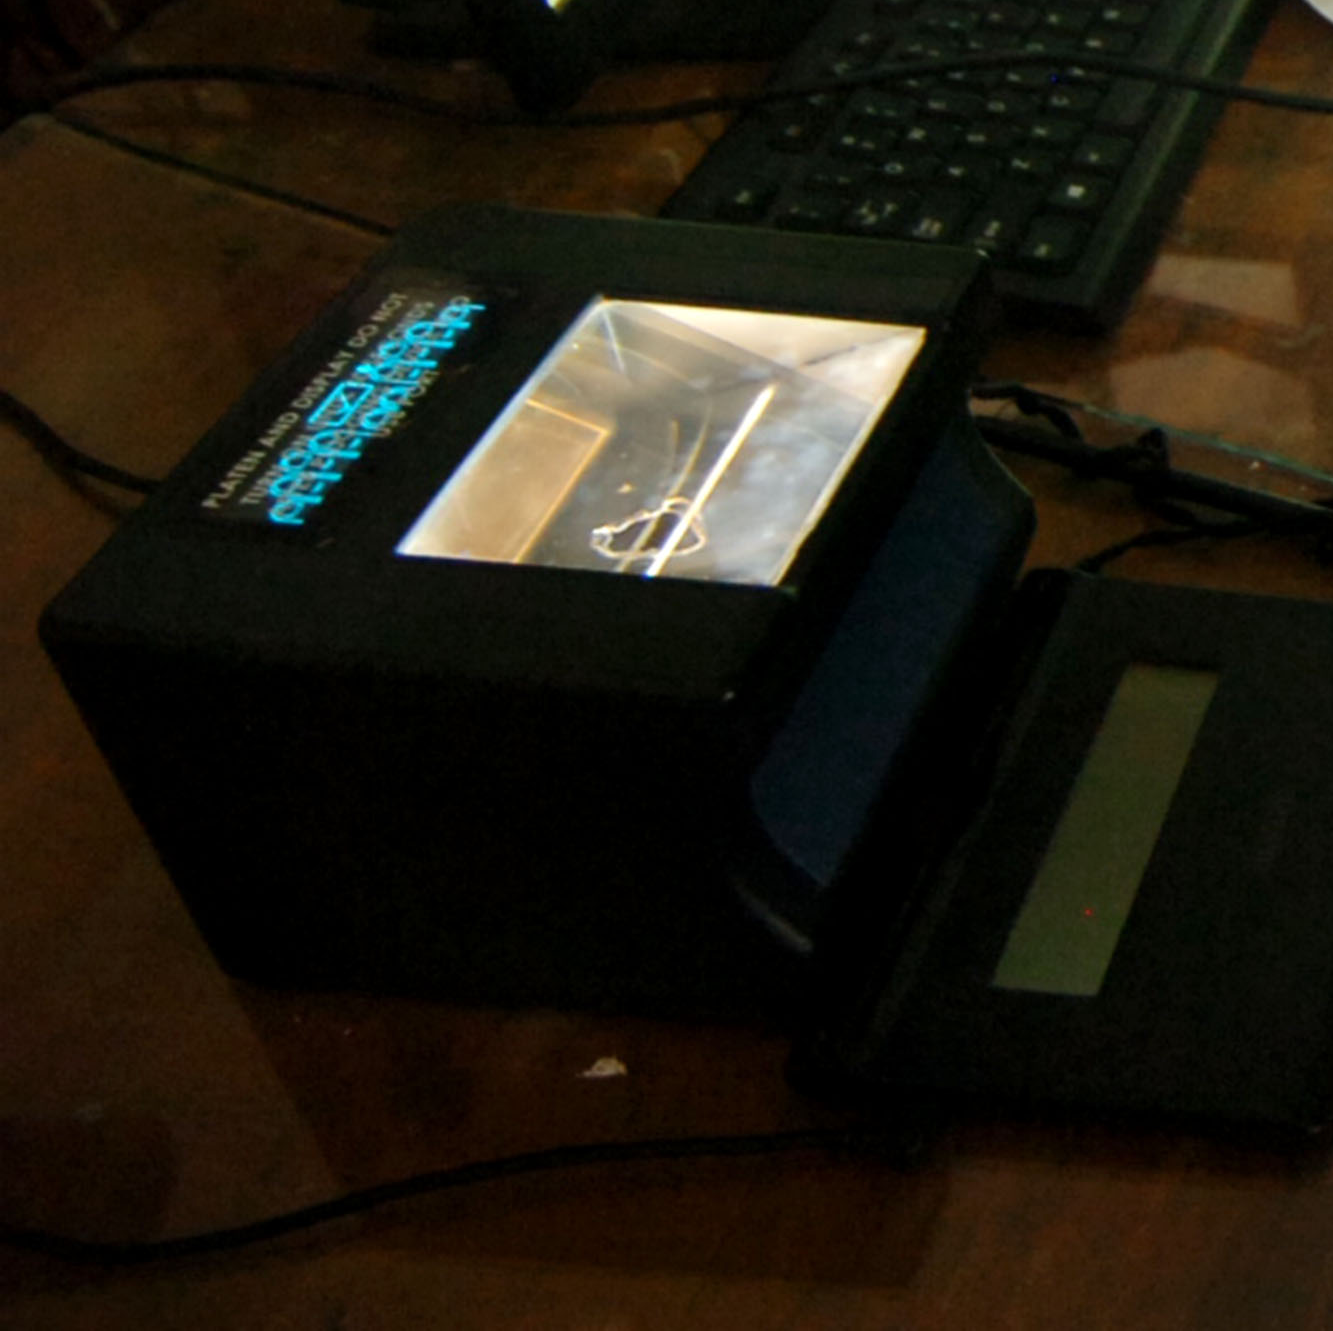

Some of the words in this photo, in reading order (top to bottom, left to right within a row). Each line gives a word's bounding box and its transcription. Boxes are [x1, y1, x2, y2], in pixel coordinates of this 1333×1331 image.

[202, 451, 266, 508] PLATEN
[259, 412, 300, 448] AND
[292, 350, 354, 408] DISPLAY
[348, 324, 379, 348] DO
[372, 292, 408, 321] NOT
